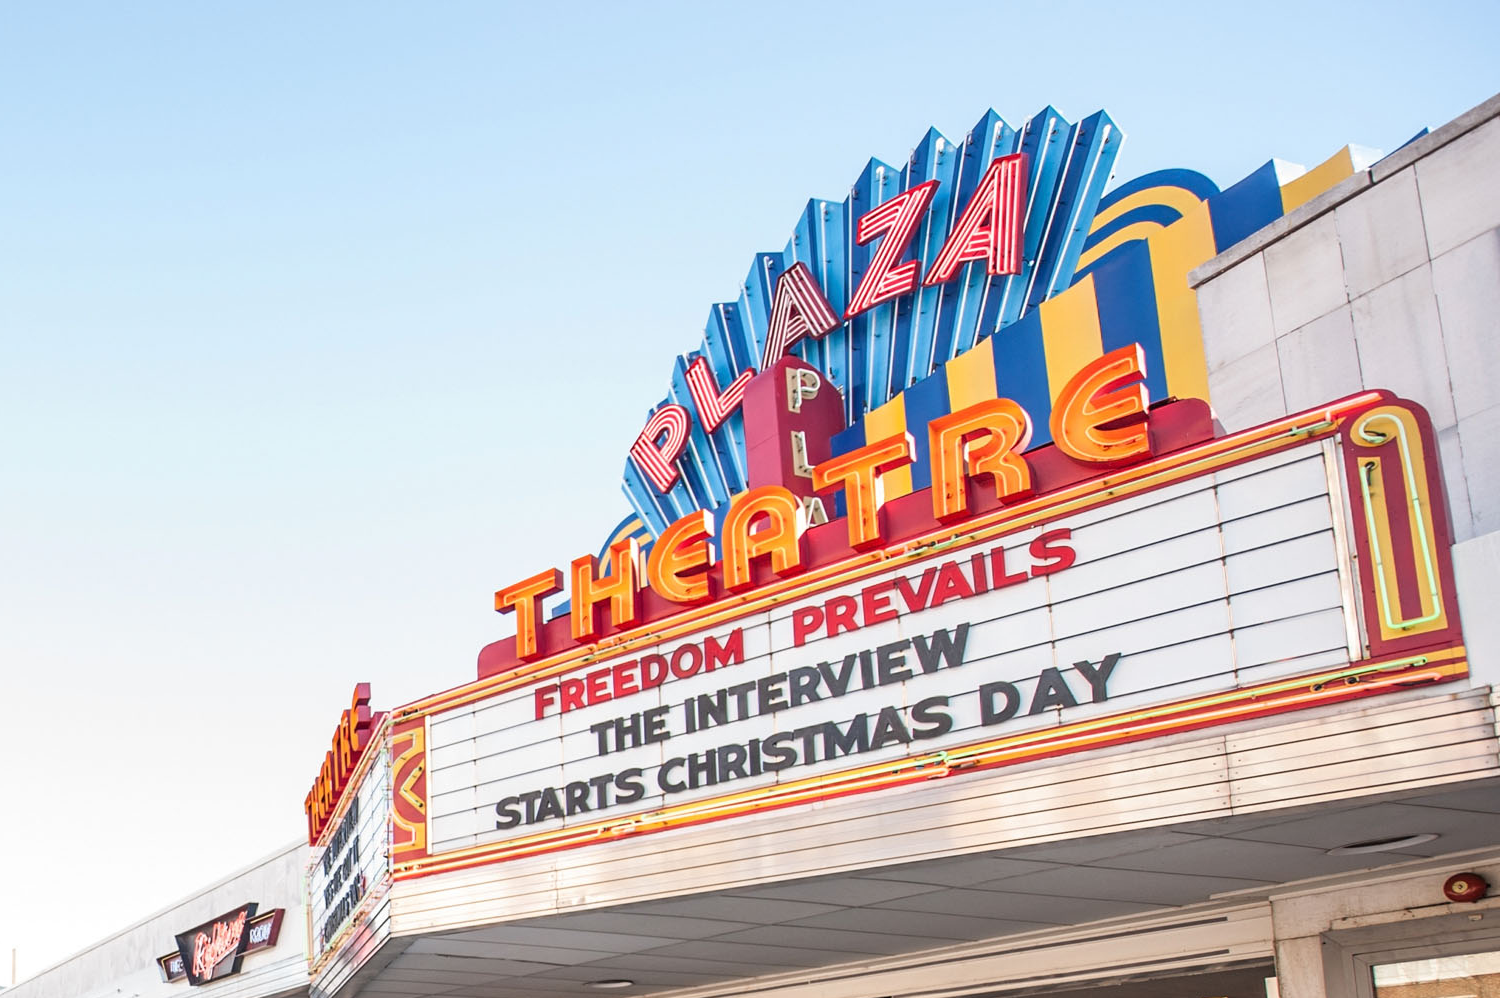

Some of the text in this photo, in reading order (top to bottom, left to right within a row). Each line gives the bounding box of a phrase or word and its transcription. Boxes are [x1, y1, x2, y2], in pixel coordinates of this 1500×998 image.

[630, 153, 1028, 494] PLAZA
[494, 342, 1152, 662] THEATRE
[534, 529, 1076, 719] FREEDOM PREVAILS
[590, 623, 970, 755] THE INTERVIEW
[496, 652, 1122, 830] STARTS CHRISTMAS DAY
